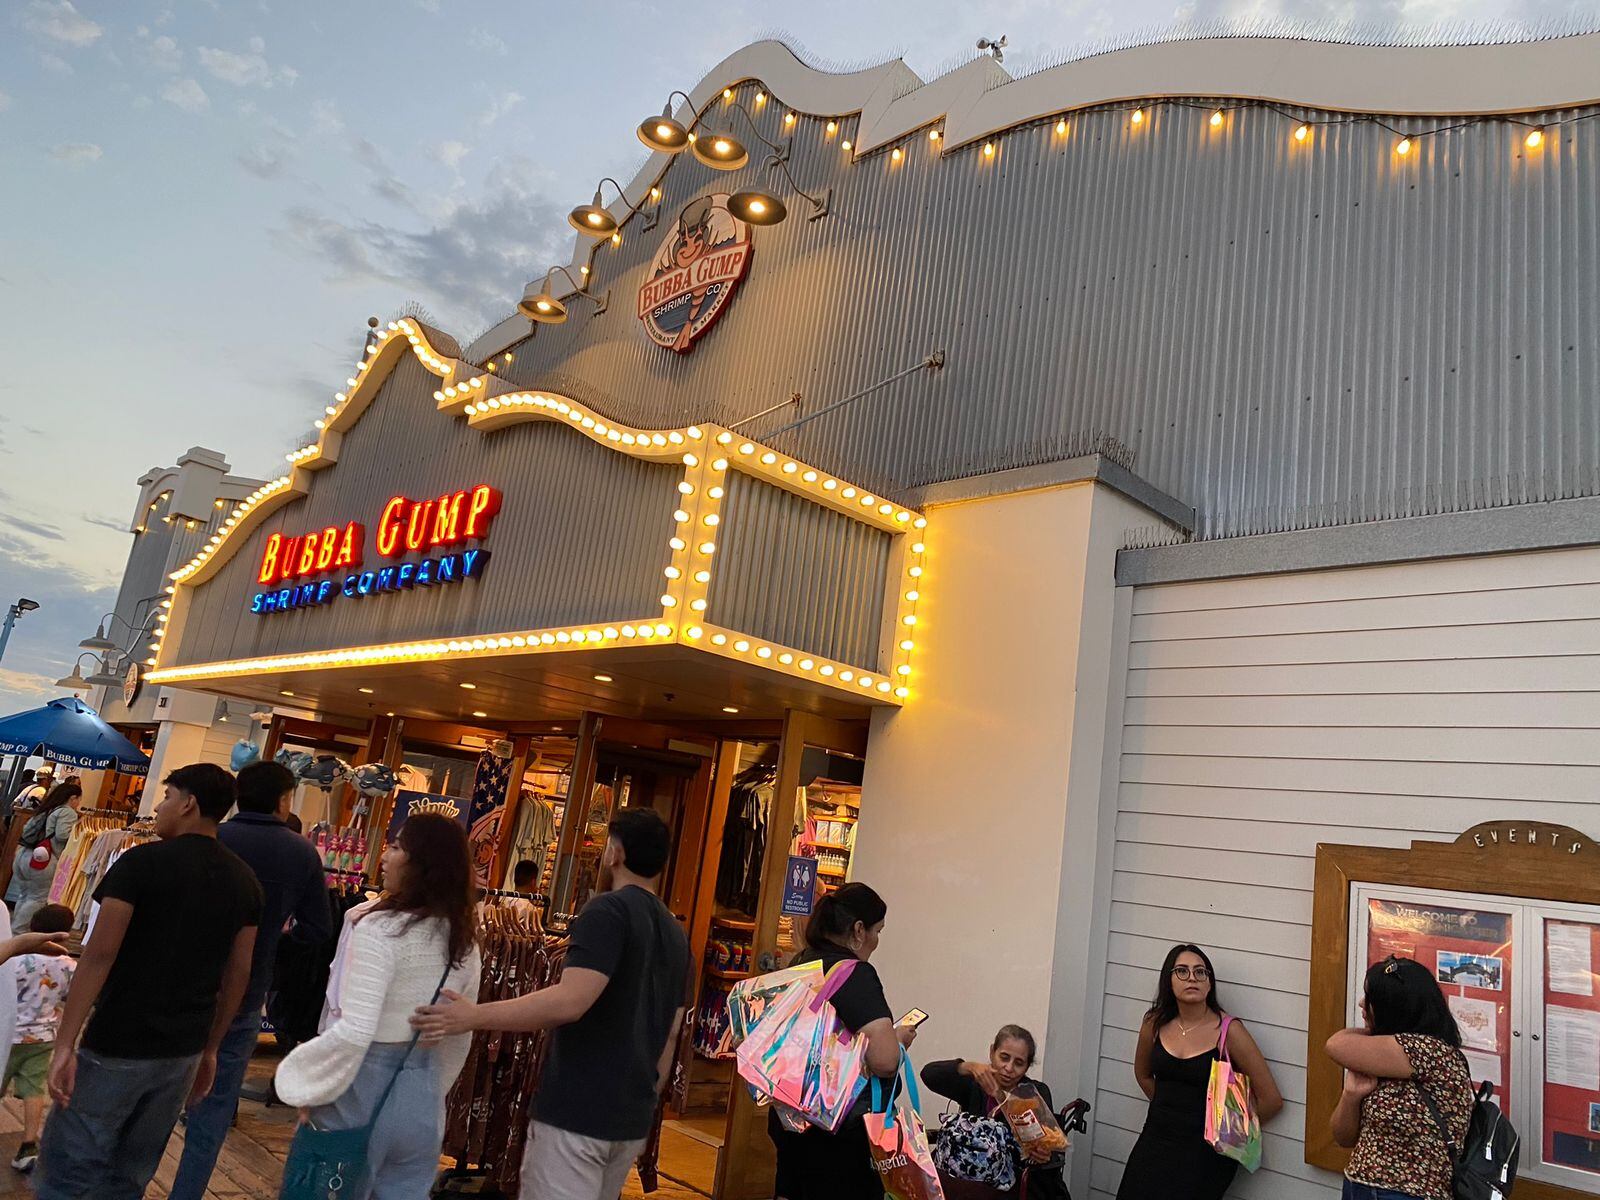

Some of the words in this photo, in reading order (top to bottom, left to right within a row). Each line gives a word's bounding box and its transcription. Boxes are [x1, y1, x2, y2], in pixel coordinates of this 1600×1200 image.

[643, 266, 692, 312] BUBBA
[697, 252, 743, 282] GUMP
[654, 294, 692, 318] SHRIMP
[706, 283, 721, 296] CO
[257, 521, 365, 585] BUBBA
[376, 484, 502, 558] GUMP
[250, 580, 341, 615] SHRIMP
[342, 550, 491, 599] COMPANY
[47, 749, 76, 764] BUBBA
[1474, 828, 1581, 854] EVENTS
[1396, 906, 1458, 922] WELCOME
